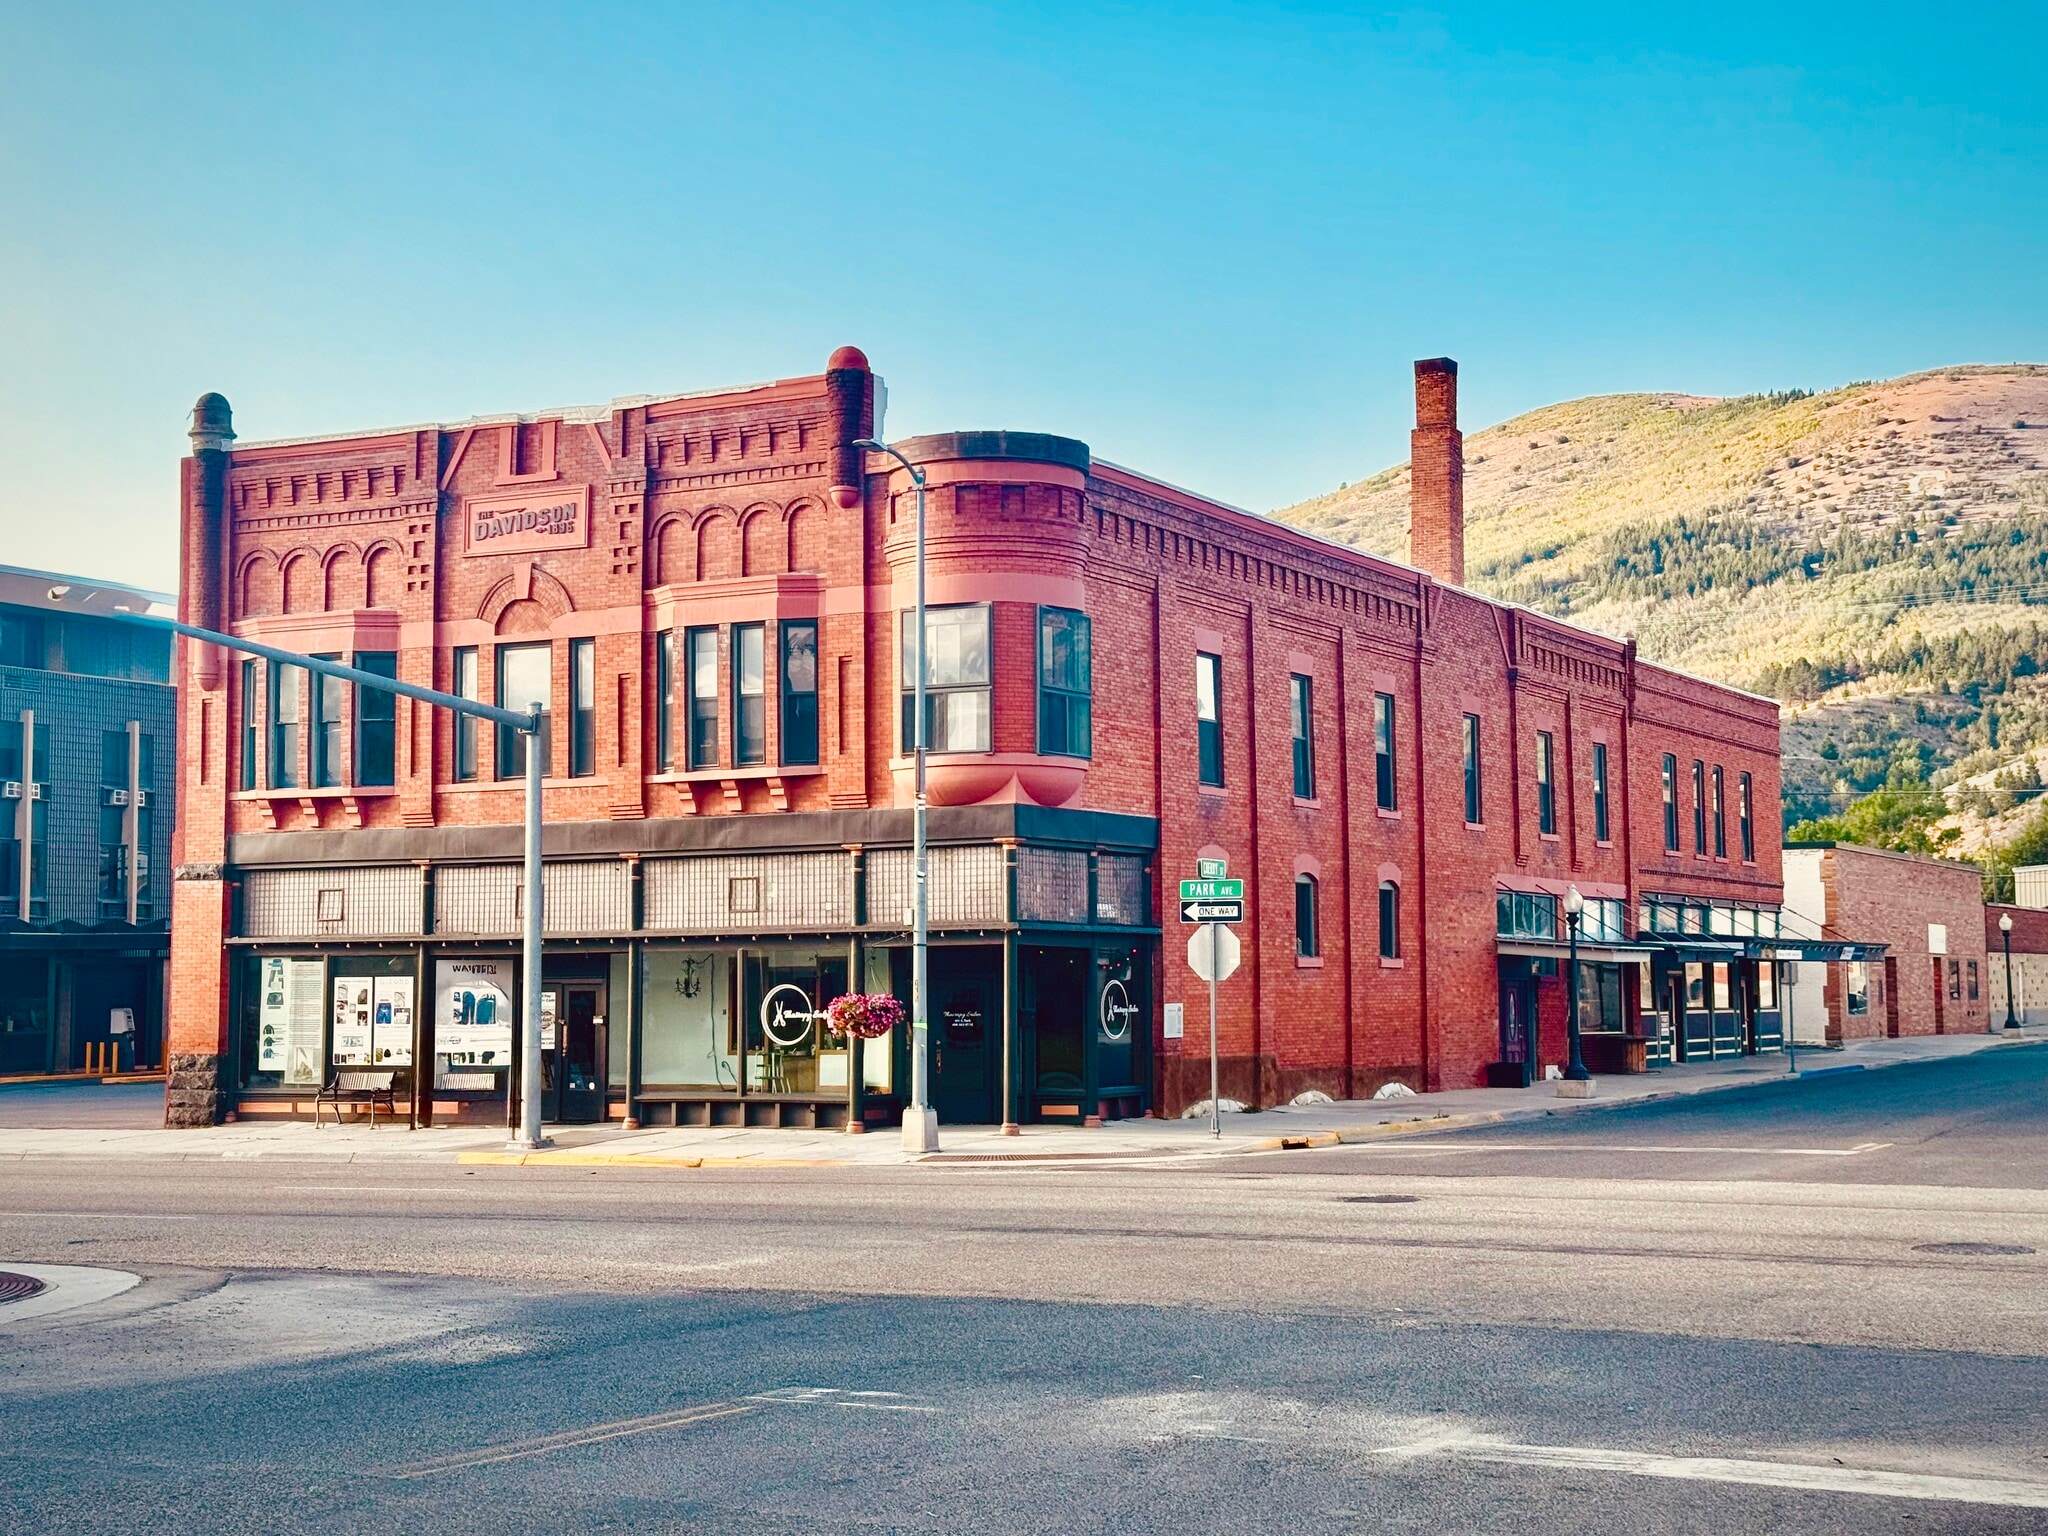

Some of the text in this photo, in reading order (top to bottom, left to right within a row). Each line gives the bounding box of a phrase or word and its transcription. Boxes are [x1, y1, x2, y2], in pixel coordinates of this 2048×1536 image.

[475, 502, 577, 541] DAVIDSON
[477, 510, 495, 521] THE
[1189, 883, 1234, 896] PARK AVE
[1199, 907, 1236, 916] ONE WAY
